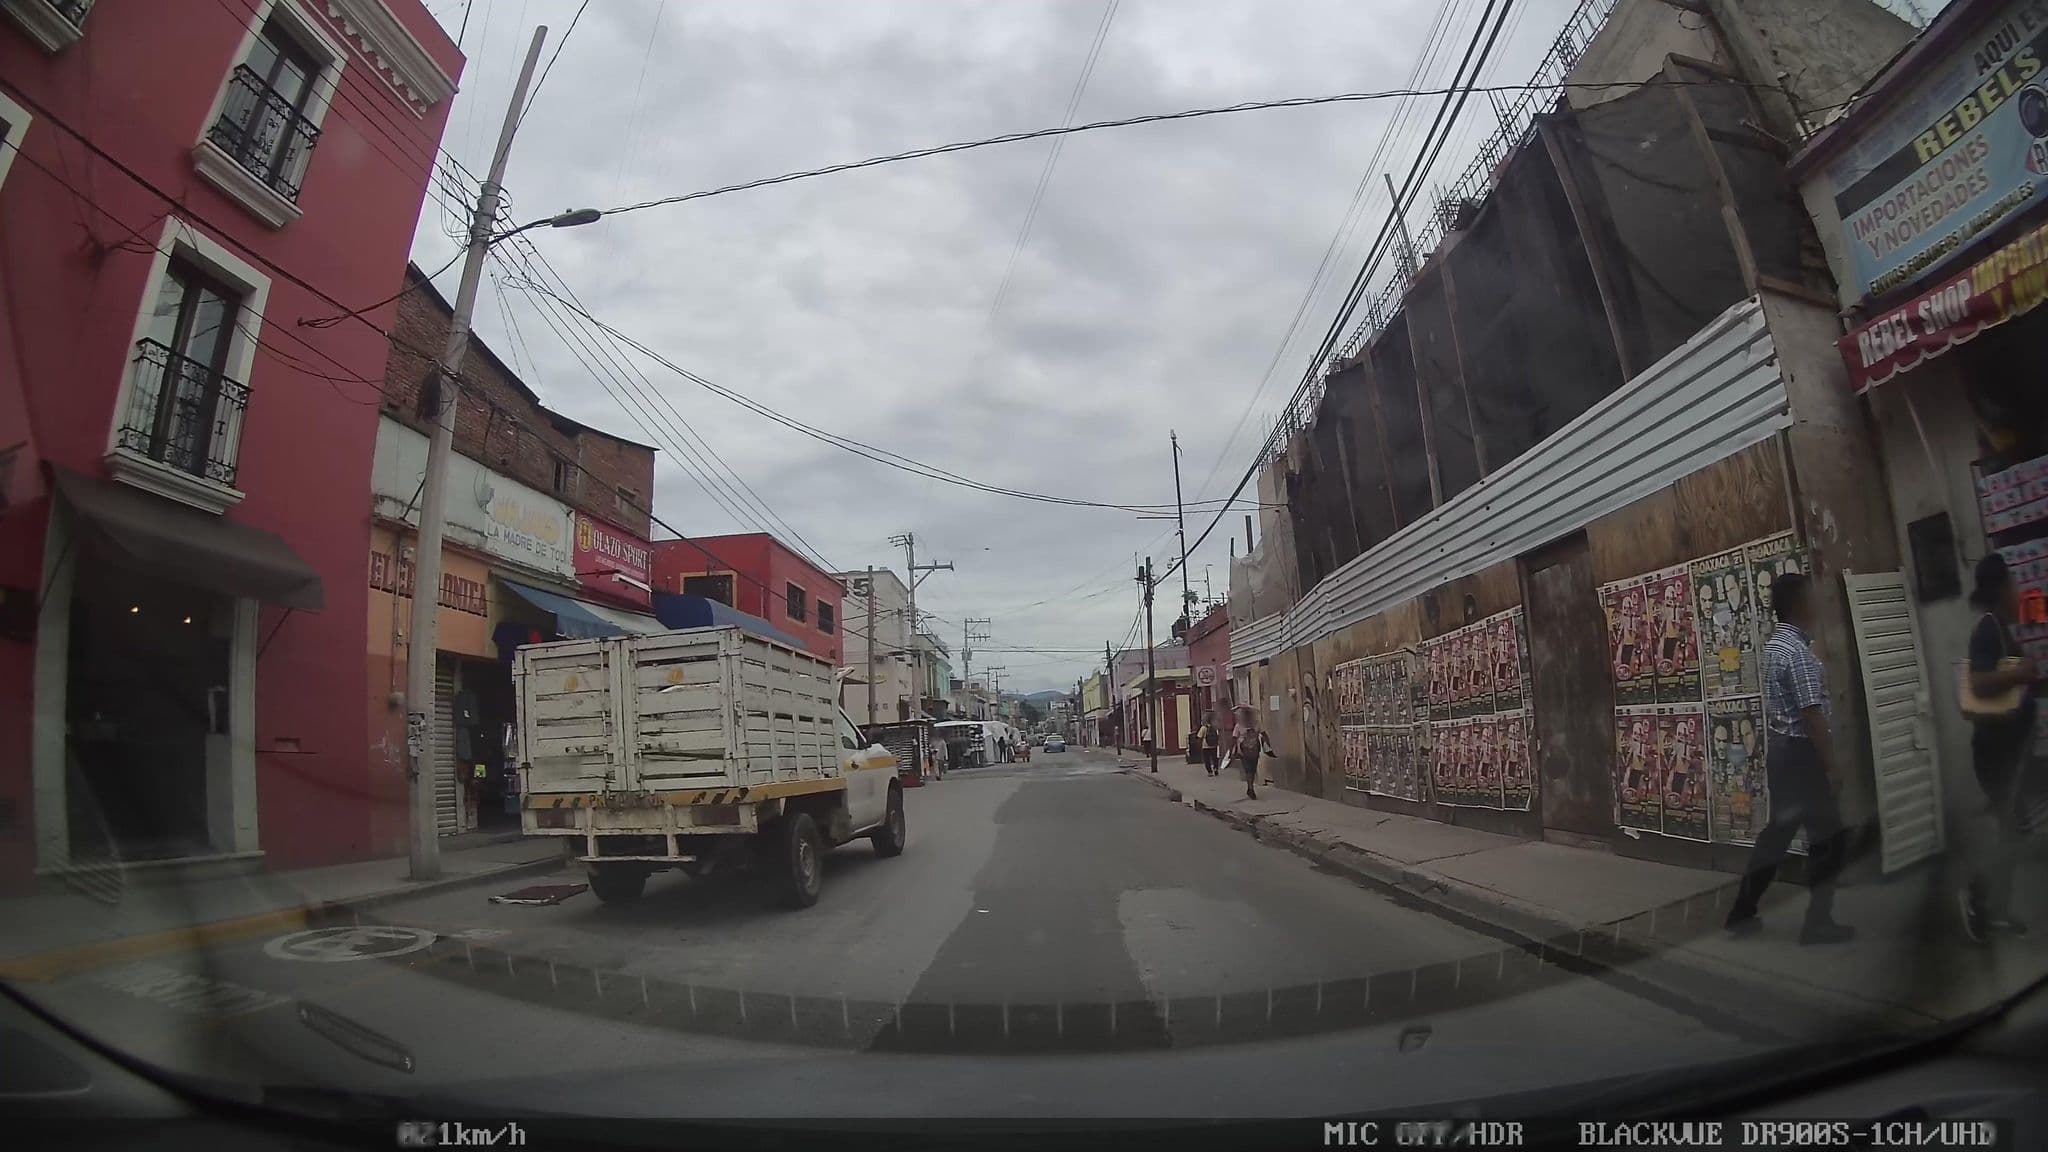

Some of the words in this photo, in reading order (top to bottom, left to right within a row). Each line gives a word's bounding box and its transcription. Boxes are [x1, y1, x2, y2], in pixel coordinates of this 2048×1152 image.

[1913, 46, 2041, 165] REBELS
[1852, 133, 1989, 241] IMPORTACIONES
[1868, 235, 1881, 258] Y
[1884, 167, 1990, 252] NOVEDADES
[1857, 309, 1919, 369] REBEL
[1918, 278, 1972, 335] SHOP
[486, 525, 499, 538] LA
[503, 529, 533, 551] MADRE
[535, 542, 547, 556] DE
[622, 542, 648, 570] SPORT
[1756, 537, 1792, 558] OAXACA
[1699, 554, 1730, 574] OAXACA
[1715, 699, 1747, 715] OAXACA
